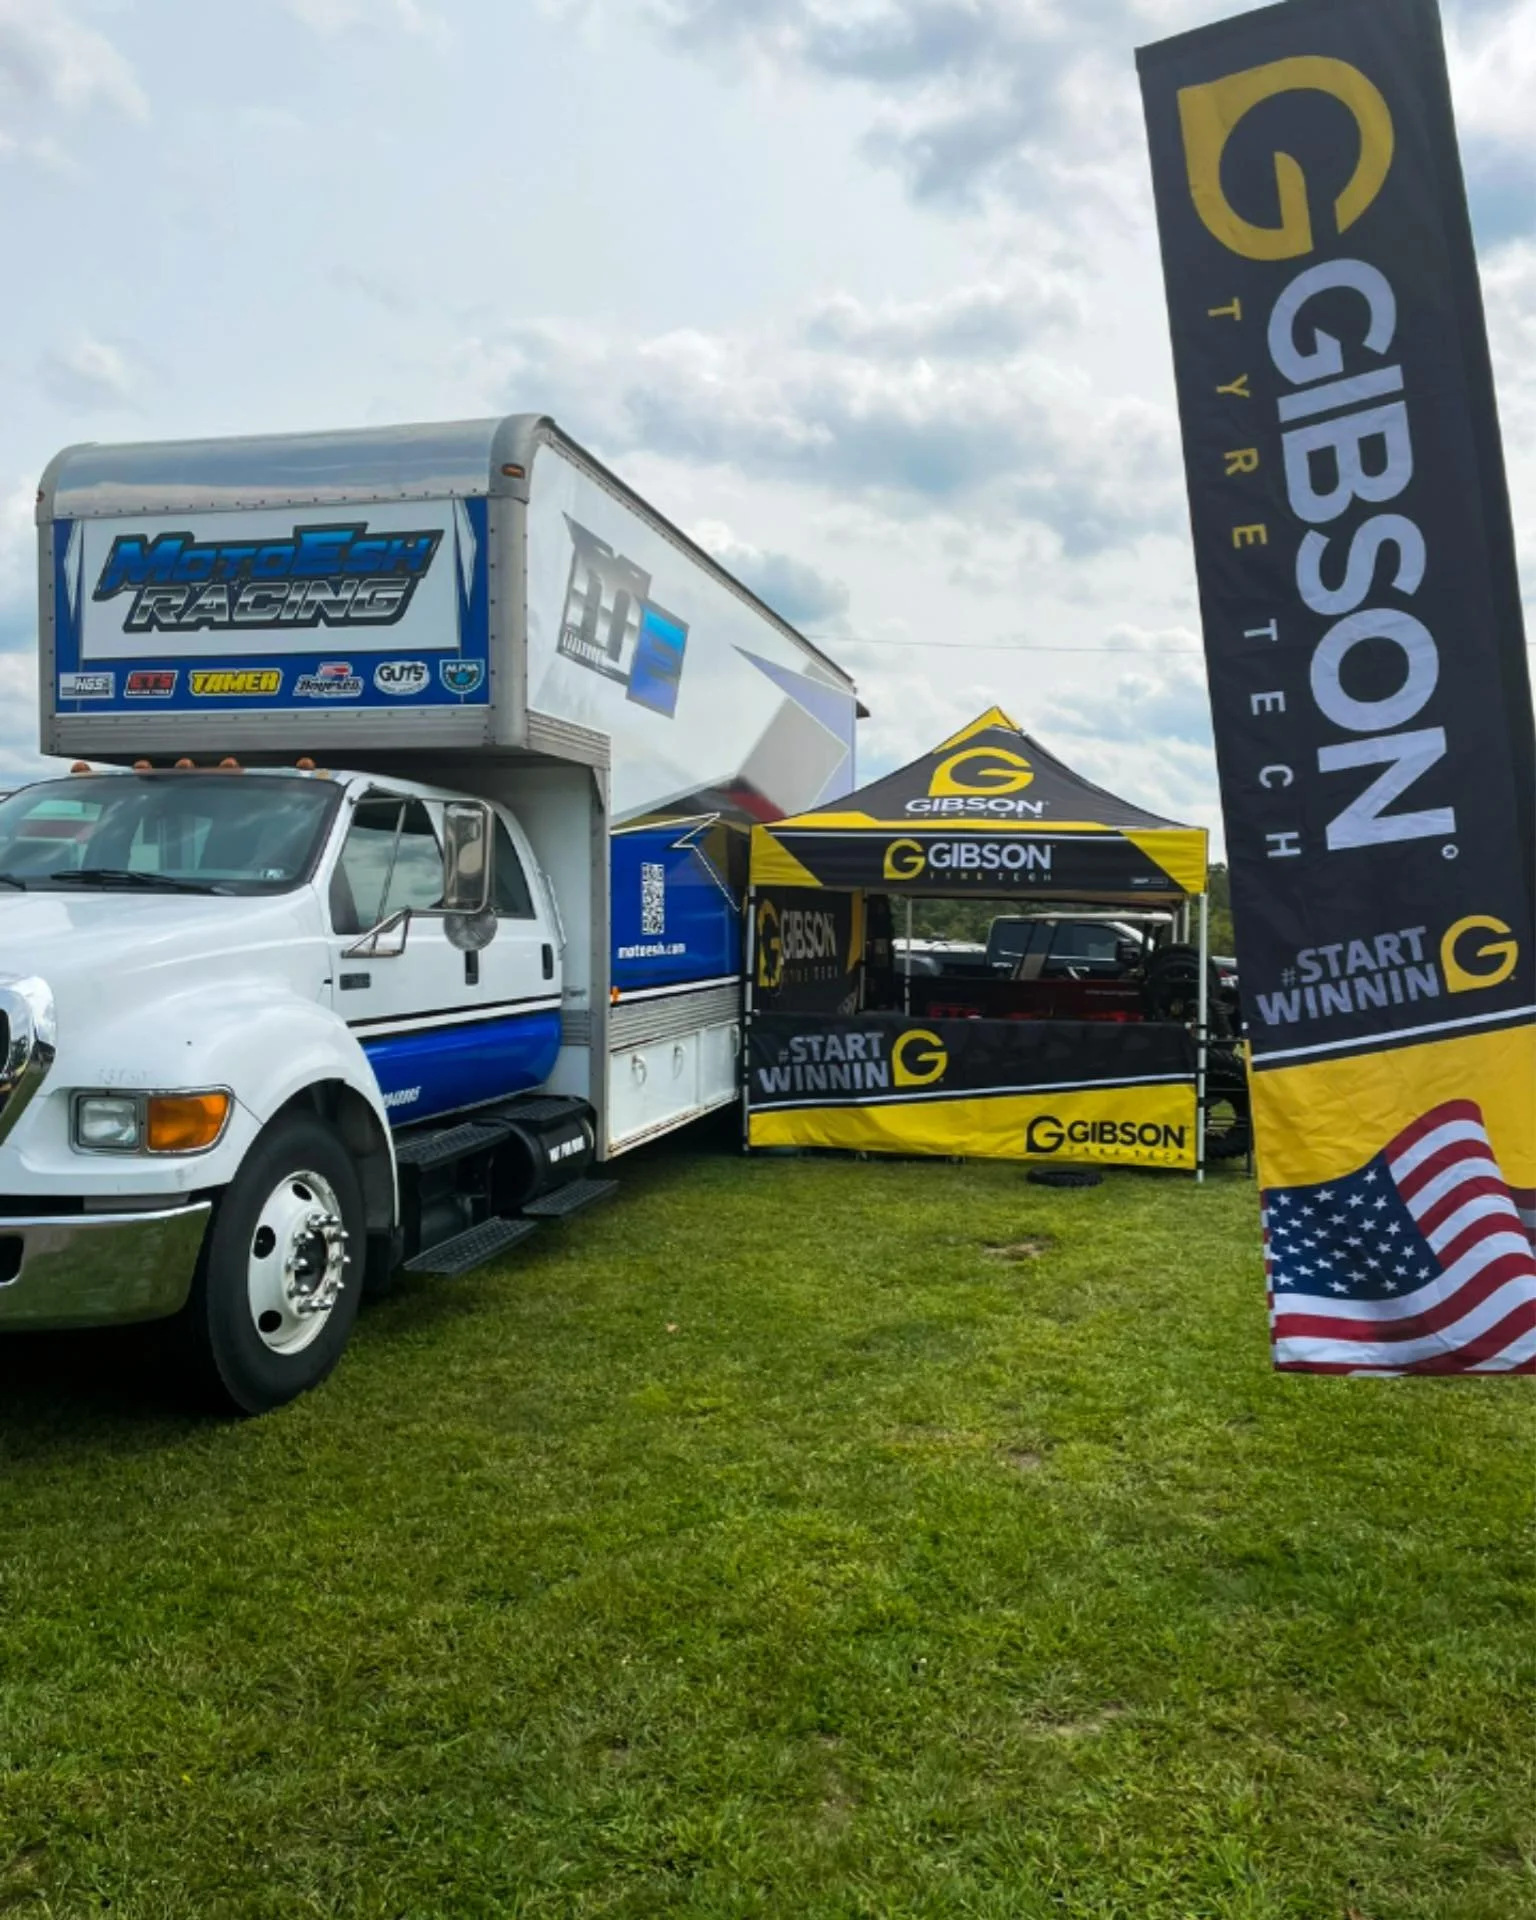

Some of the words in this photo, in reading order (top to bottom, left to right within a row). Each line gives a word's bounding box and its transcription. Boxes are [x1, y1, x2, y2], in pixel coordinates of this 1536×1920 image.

[1208, 298, 1279, 548] TYRE
[1267, 258, 1457, 851] GIBSON
[131, 577, 411, 625] RACING
[131, 673, 174, 689] ETS
[193, 671, 279, 693] TAMER
[378, 665, 425, 682] GUTS
[1243, 618, 1302, 858] TECH
[905, 798, 1044, 814] GIBSON
[928, 842, 1052, 869] GIBSON
[781, 909, 837, 960] GIBSON
[1281, 926, 1427, 988] #START
[1256, 963, 1440, 1026] WINNIN
[758, 1060, 889, 1093] WINNIN
[1067, 1119, 1185, 1149] GIBSON
